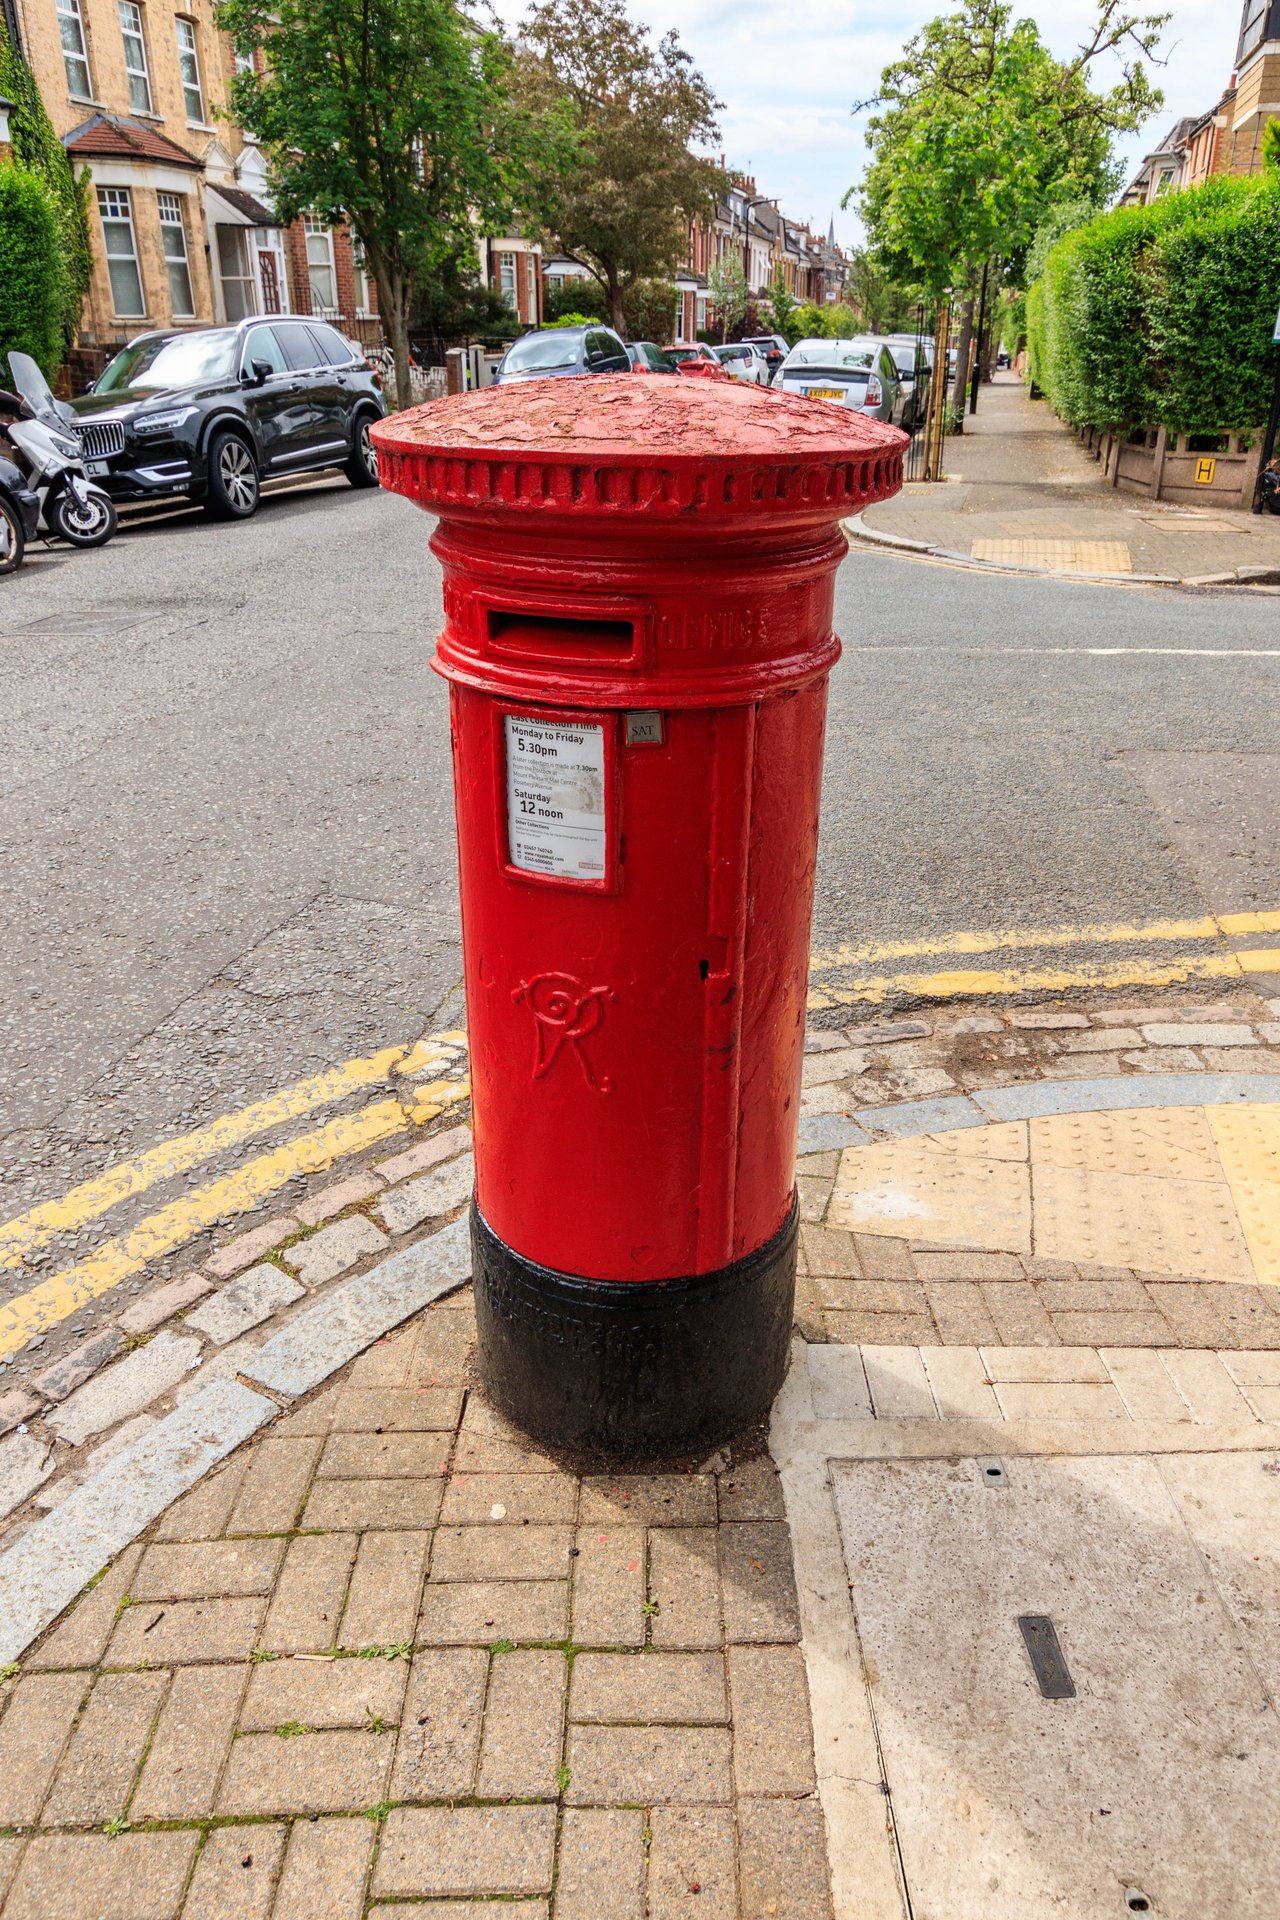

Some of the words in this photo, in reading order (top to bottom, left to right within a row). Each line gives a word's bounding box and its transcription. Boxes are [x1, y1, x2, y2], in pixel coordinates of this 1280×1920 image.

[1198, 460, 1212, 480] H
[512, 726, 543, 740] Monday
[556, 732, 584, 744] Friday
[632, 724, 654, 736] SAT
[518, 738, 558, 757] 5.30pm
[514, 788, 551, 804] Saturday
[520, 800, 536, 814] 12
[538, 808, 563, 819] noon
[527, 821, 549, 830] Collections
[524, 850, 564, 862] www.royalmail.com
